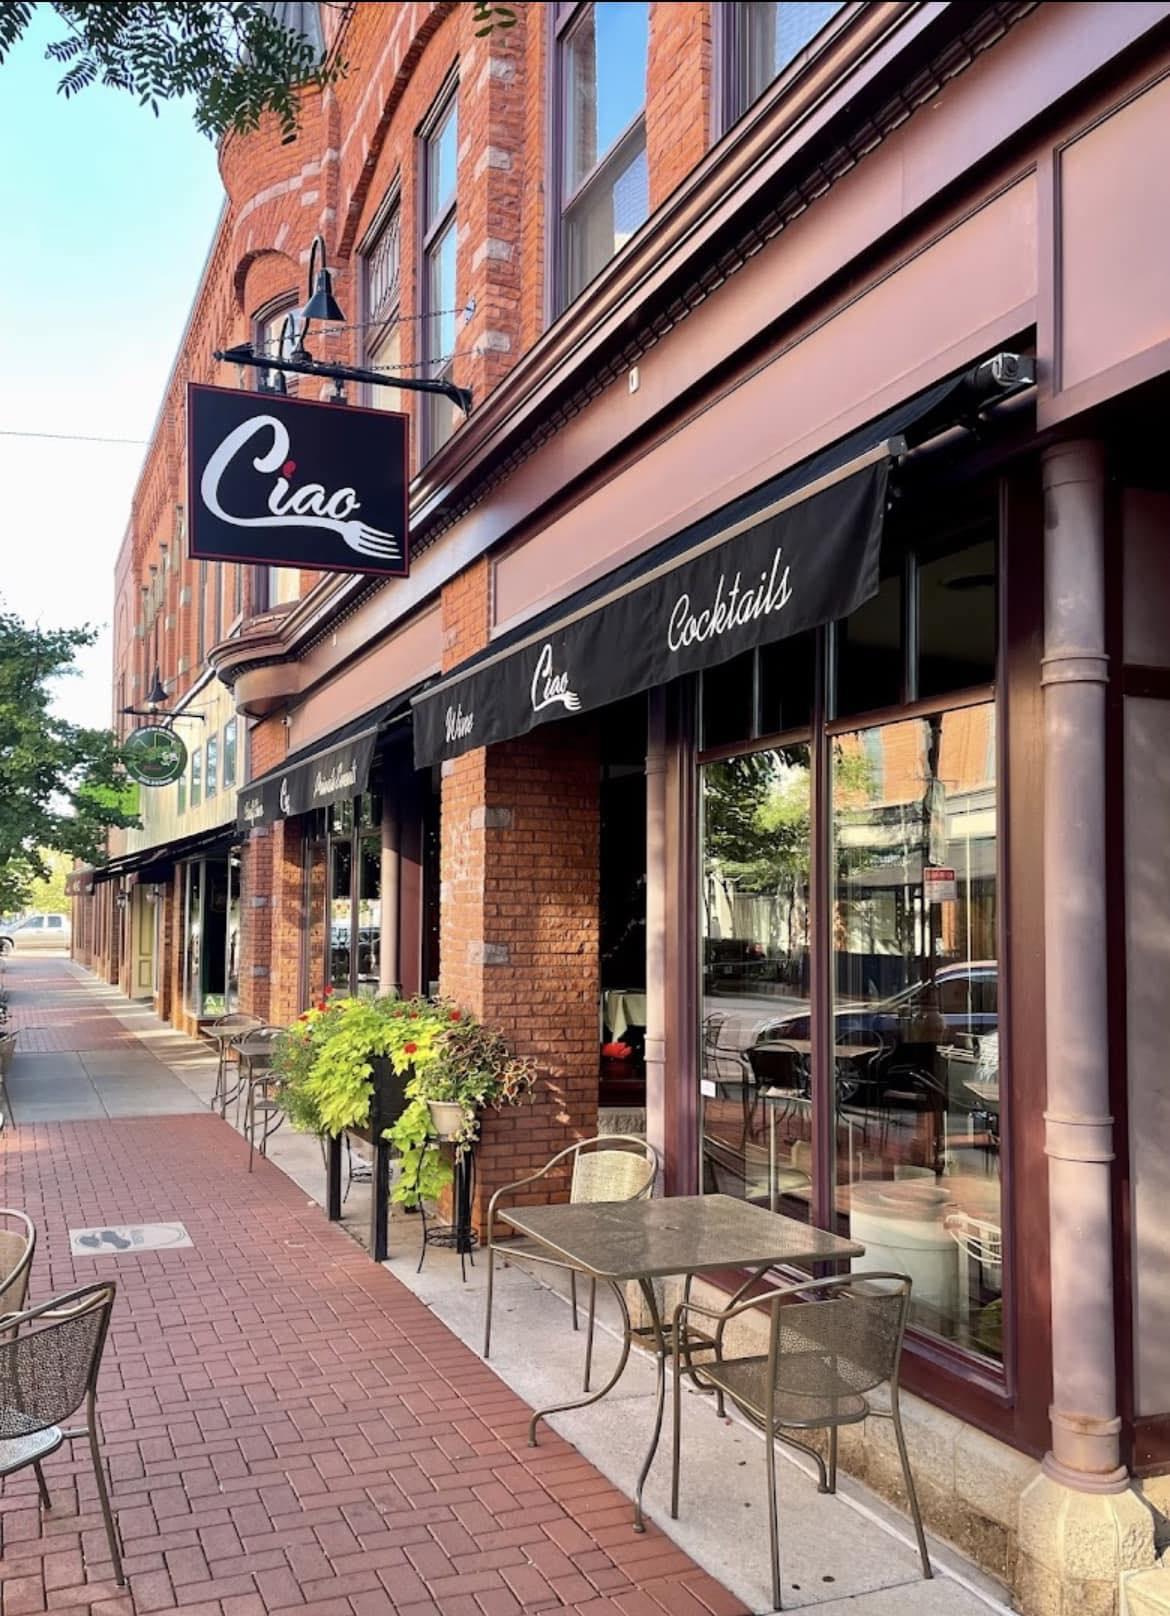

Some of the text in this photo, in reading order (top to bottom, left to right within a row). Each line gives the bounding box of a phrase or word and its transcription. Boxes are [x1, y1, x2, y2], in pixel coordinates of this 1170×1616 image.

[201, 415, 402, 559] Ciao
[446, 547, 793, 743] Wine Ciao Cocktails
